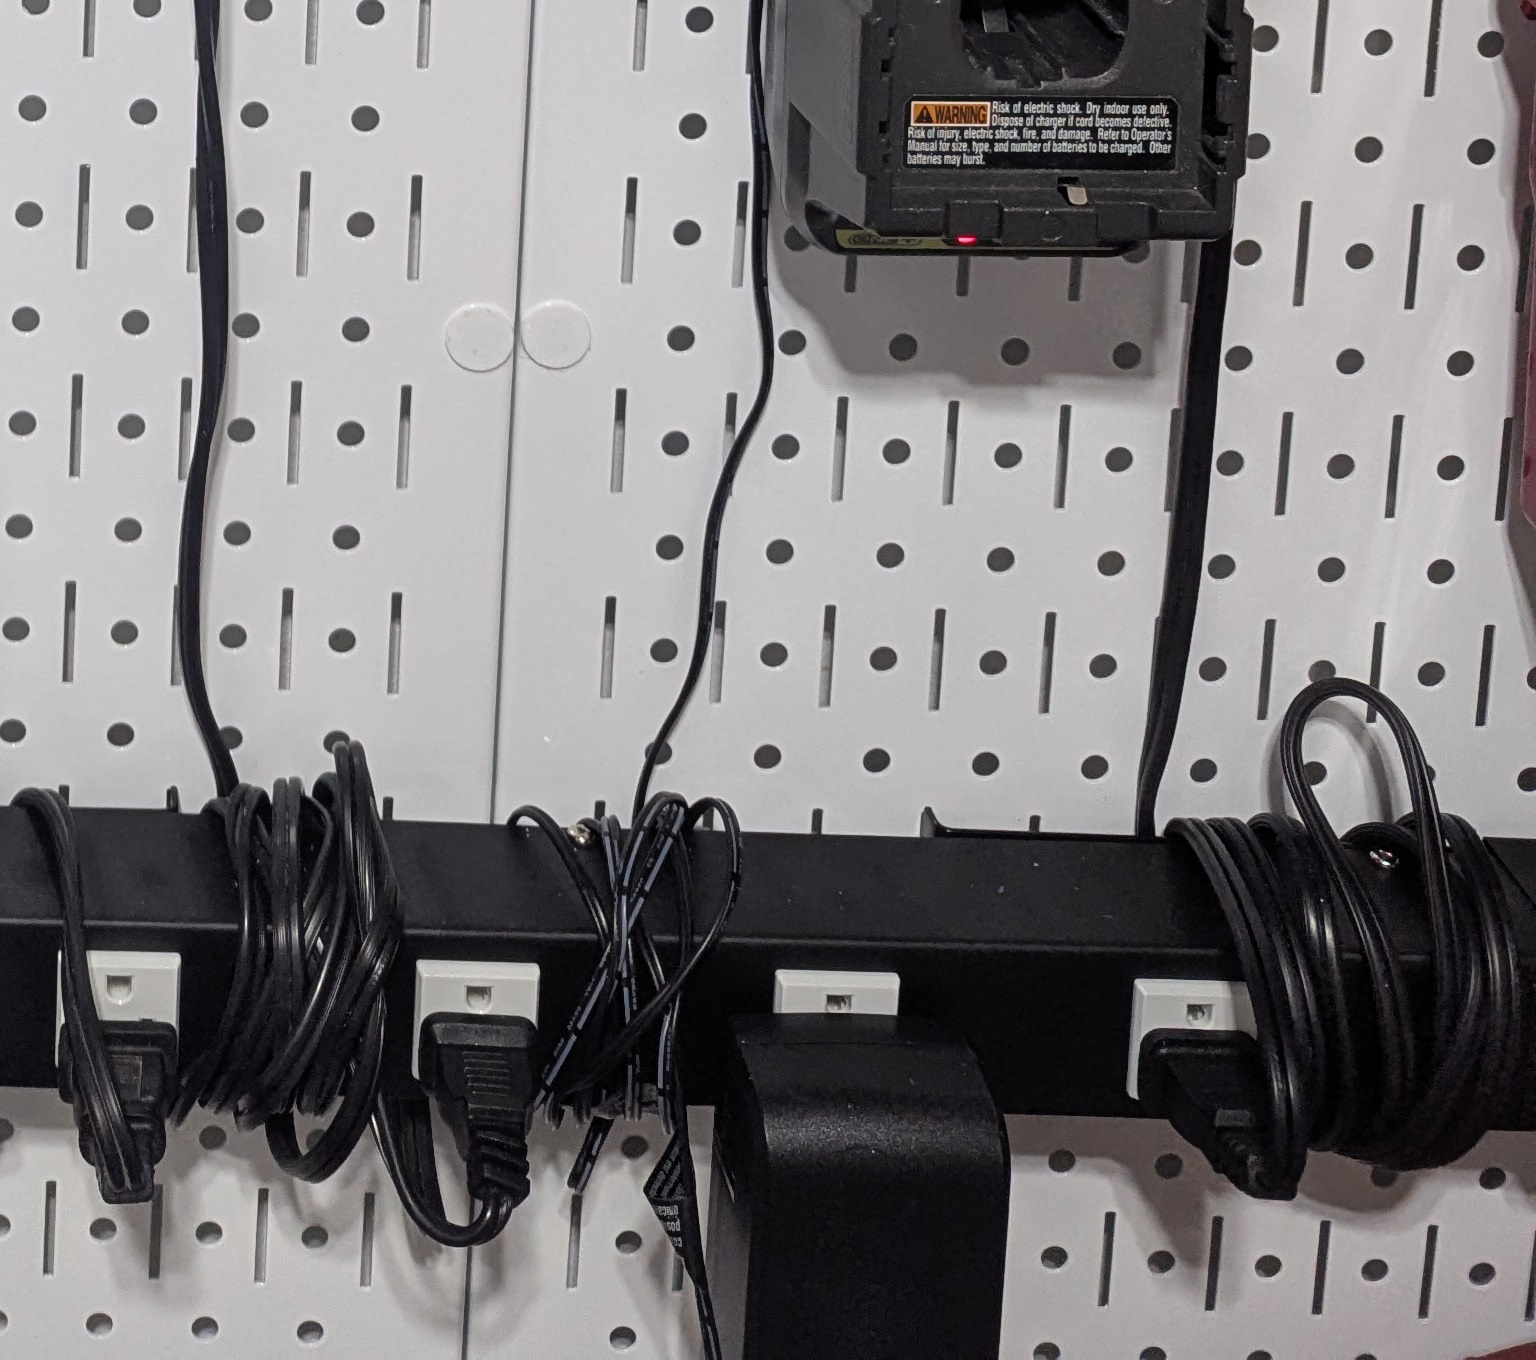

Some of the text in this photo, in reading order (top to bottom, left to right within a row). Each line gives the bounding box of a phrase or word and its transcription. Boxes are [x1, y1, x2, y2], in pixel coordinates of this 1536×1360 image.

[935, 105, 987, 124] WARNING
[992, 102, 1010, 113] Risk
[1013, 102, 1021, 114] of
[1024, 102, 1054, 114] electric
[1057, 102, 1082, 114] shock.
[1087, 103, 1099, 115] Dry
[1132, 105, 1146, 114] use
[1150, 104, 1169, 115] only.
[992, 114, 1023, 128] Dispose
[1026, 115, 1033, 127] of
[1036, 116, 1065, 129] charger
[1076, 116, 1093, 127] cord
[1096, 116, 1131, 128] becomes
[1134, 116, 1172, 128] defective.
